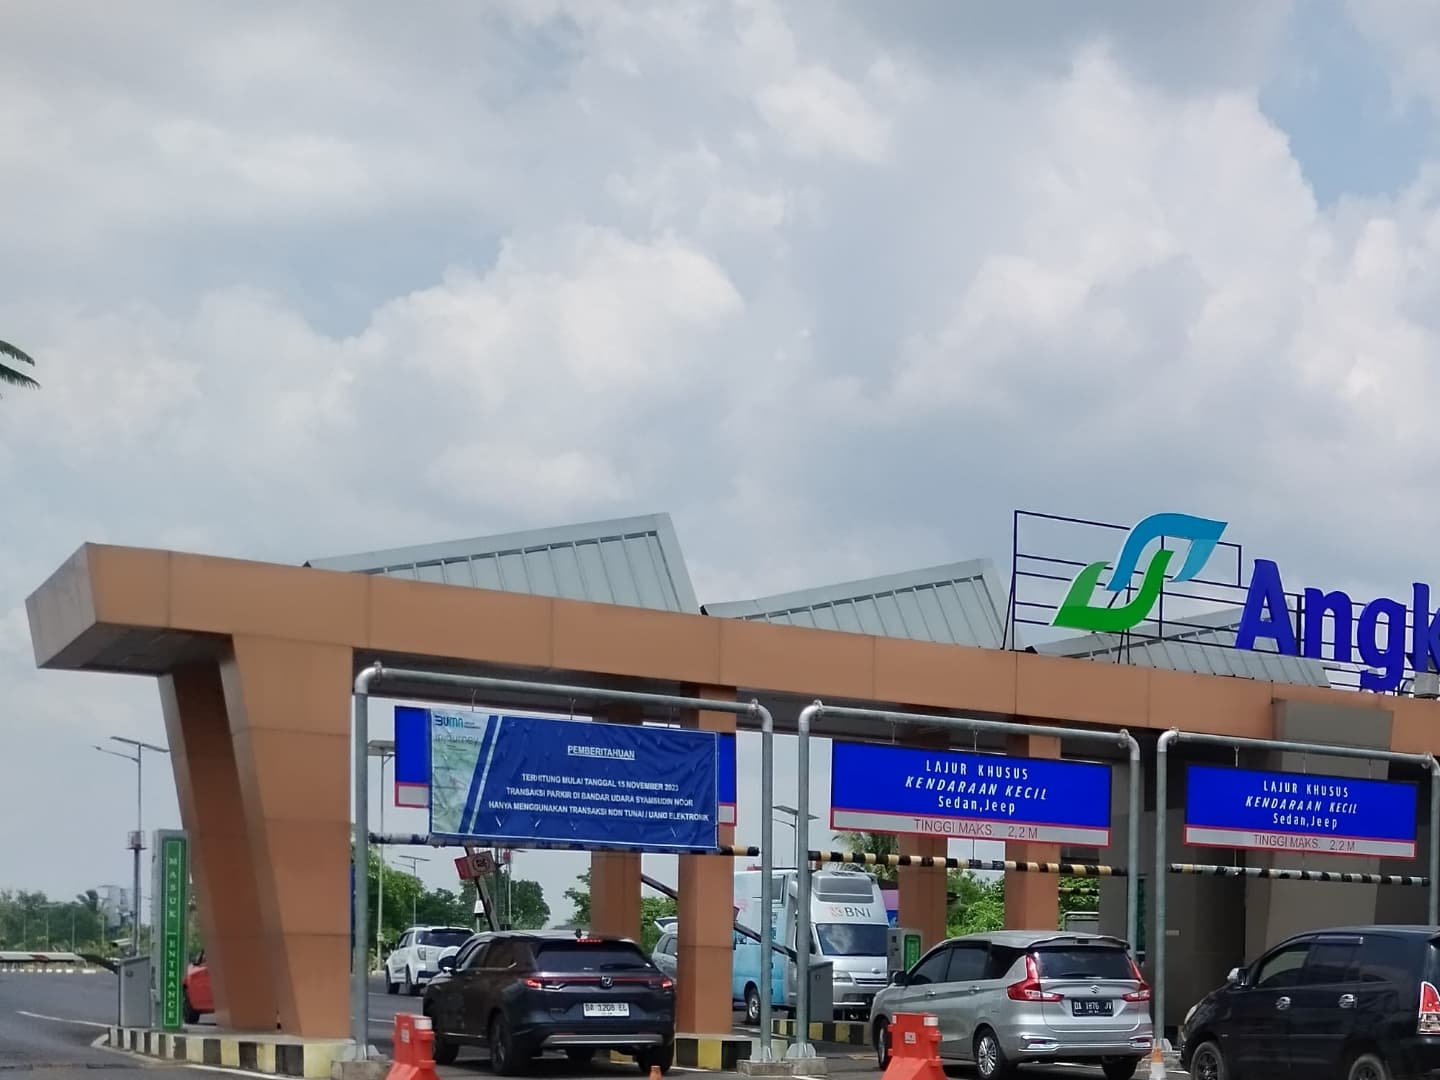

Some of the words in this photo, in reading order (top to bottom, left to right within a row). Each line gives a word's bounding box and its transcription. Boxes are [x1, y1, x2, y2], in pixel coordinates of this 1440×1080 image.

[567, 745, 636, 760] PEMBERITAHUAN
[926, 759, 968, 776] LAJUR
[978, 763, 1029, 780] KHUSUS
[562, 776, 583, 786] MULAI
[584, 778, 616, 788] TANGGAL
[626, 781, 663, 792] NOVEMBER
[905, 776, 998, 796] KENDARAAN
[1005, 785, 1049, 801] KECIL
[1263, 780, 1298, 794] LAJUR
[1306, 783, 1349, 798] KHUSUS
[506, 786, 545, 798] TRANSAKSI
[546, 790, 572, 800] PARKIR
[573, 791, 580, 800] DI
[581, 792, 610, 802] BANDAR
[611, 794, 634, 804] UDARA
[1245, 795, 1322, 812] KENDARAAN
[1329, 802, 1359, 814] KECIL
[489, 800, 512, 810] HANYA
[513, 802, 568, 813] MENGGUNAKAN
[569, 805, 607, 816] TRANSAKSI
[608, 808, 623, 817] NON
[624, 809, 644, 818] TUNAI
[649, 811, 668, 820] UANG
[669, 812, 709, 822] ELEKTRONIK
[938, 796, 1016, 816] Sedan,Jeep
[914, 818, 957, 834] TINGGI
[1028, 827, 1038, 839] M
[1273, 812, 1338, 830] Sedan,Jeep
[1253, 834, 1288, 848] TINGGI
[168, 857, 178, 919] MASUK
[844, 906, 871, 918] BNI
[167, 939, 177, 1020] ENTRANCE
